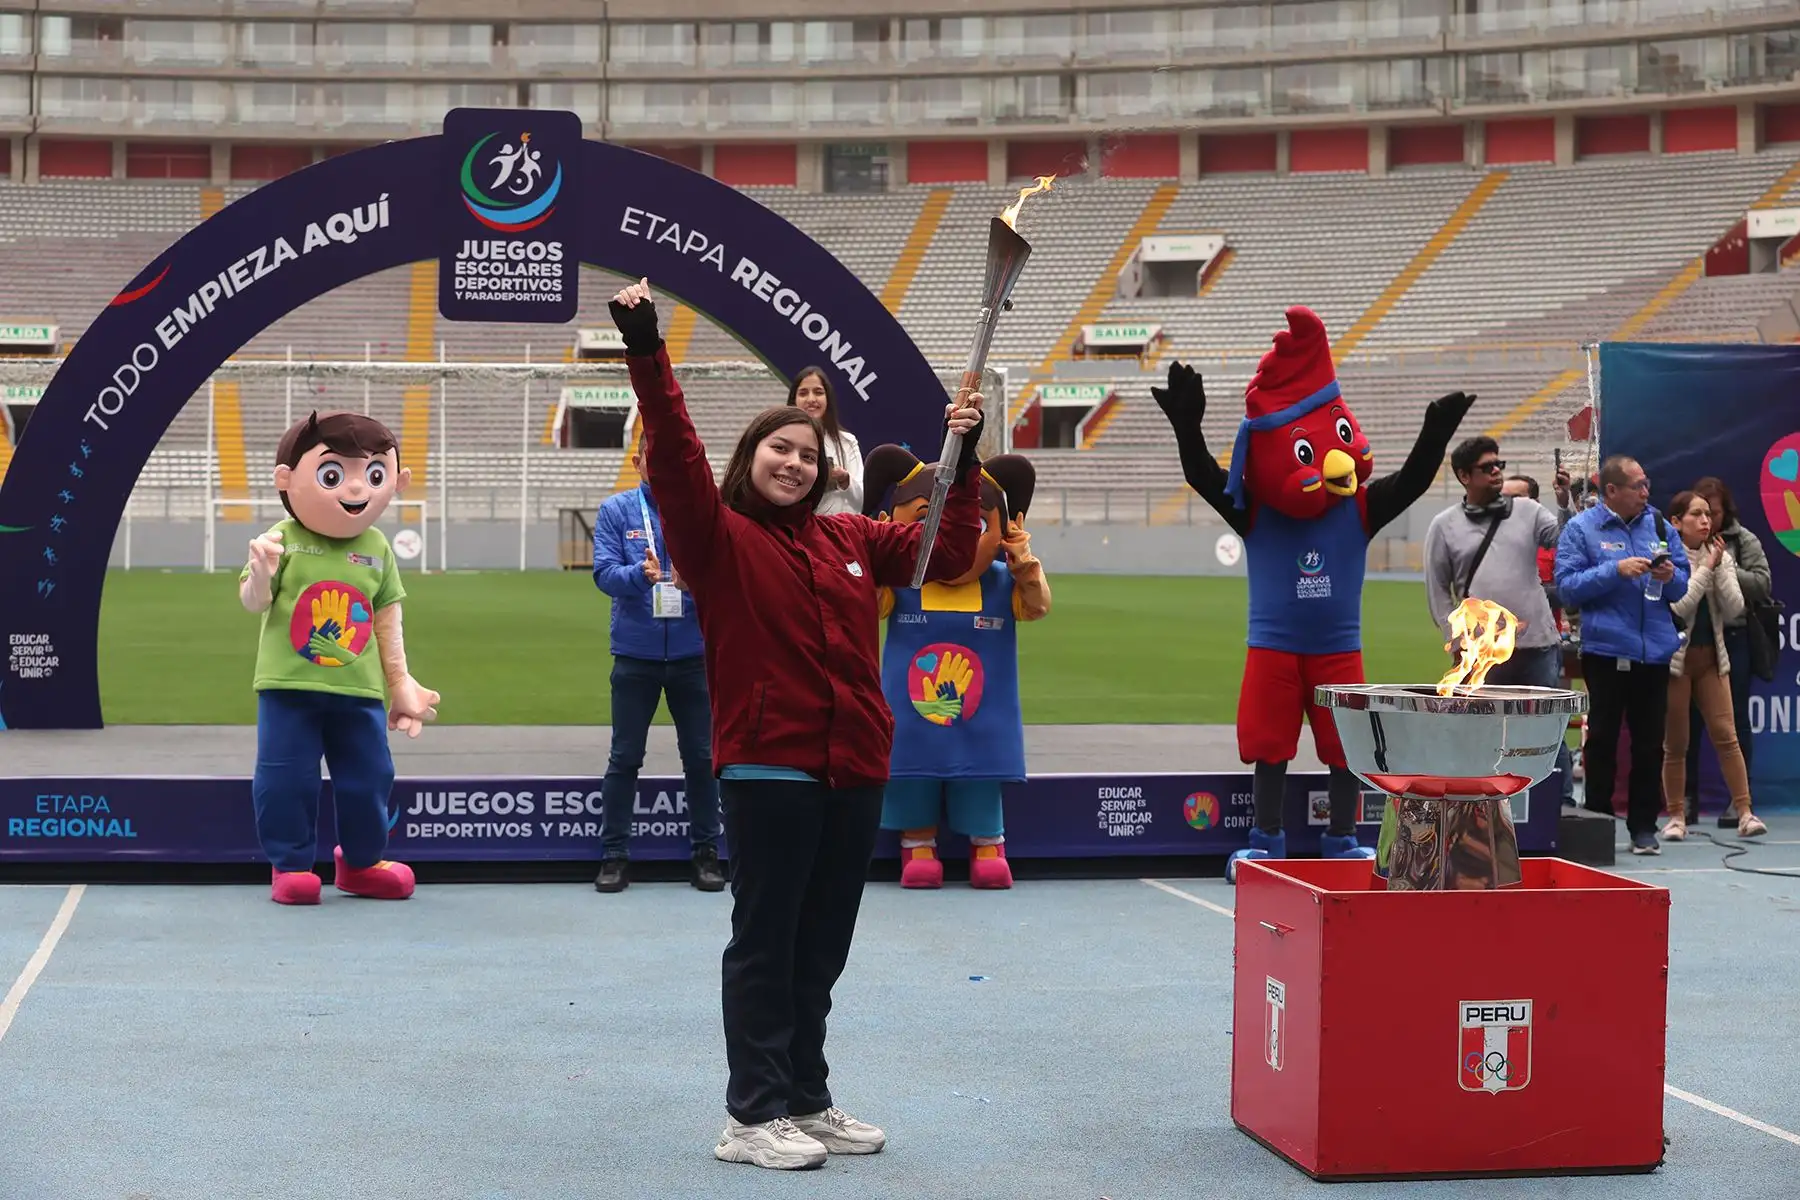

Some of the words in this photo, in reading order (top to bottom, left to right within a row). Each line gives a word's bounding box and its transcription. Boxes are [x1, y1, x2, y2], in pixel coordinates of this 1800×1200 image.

[456, 240, 563, 261] JUEGOS
[455, 261, 563, 277] ESCOLARES
[455, 277, 563, 292] DEPORTIVOS
[455, 291, 463, 300] Y
[465, 292, 562, 302] PARADEPORTIVOS
[620, 206, 724, 273] ETAPA
[730, 257, 879, 402] REGIONAL
[83, 342, 159, 431] TODO
[154, 236, 299, 351] EMPIEZA
[302, 192, 389, 255] AQUÍ
[1095, 328, 1148, 338] SALIDA
[9, 634, 50, 645] EDUCAR
[19, 656, 60, 667] EDUCAR
[1098, 787, 1142, 799] EDUCAR
[36, 795, 111, 813] ETAPA
[406, 791, 535, 815] JUEGOS
[1108, 811, 1153, 824] EDUCAR
[8, 818, 138, 837] REGIONAL
[406, 822, 533, 838] DEPORTIVOS
[541, 823, 553, 837] Y
[1466, 1006, 1526, 1022] PERU
